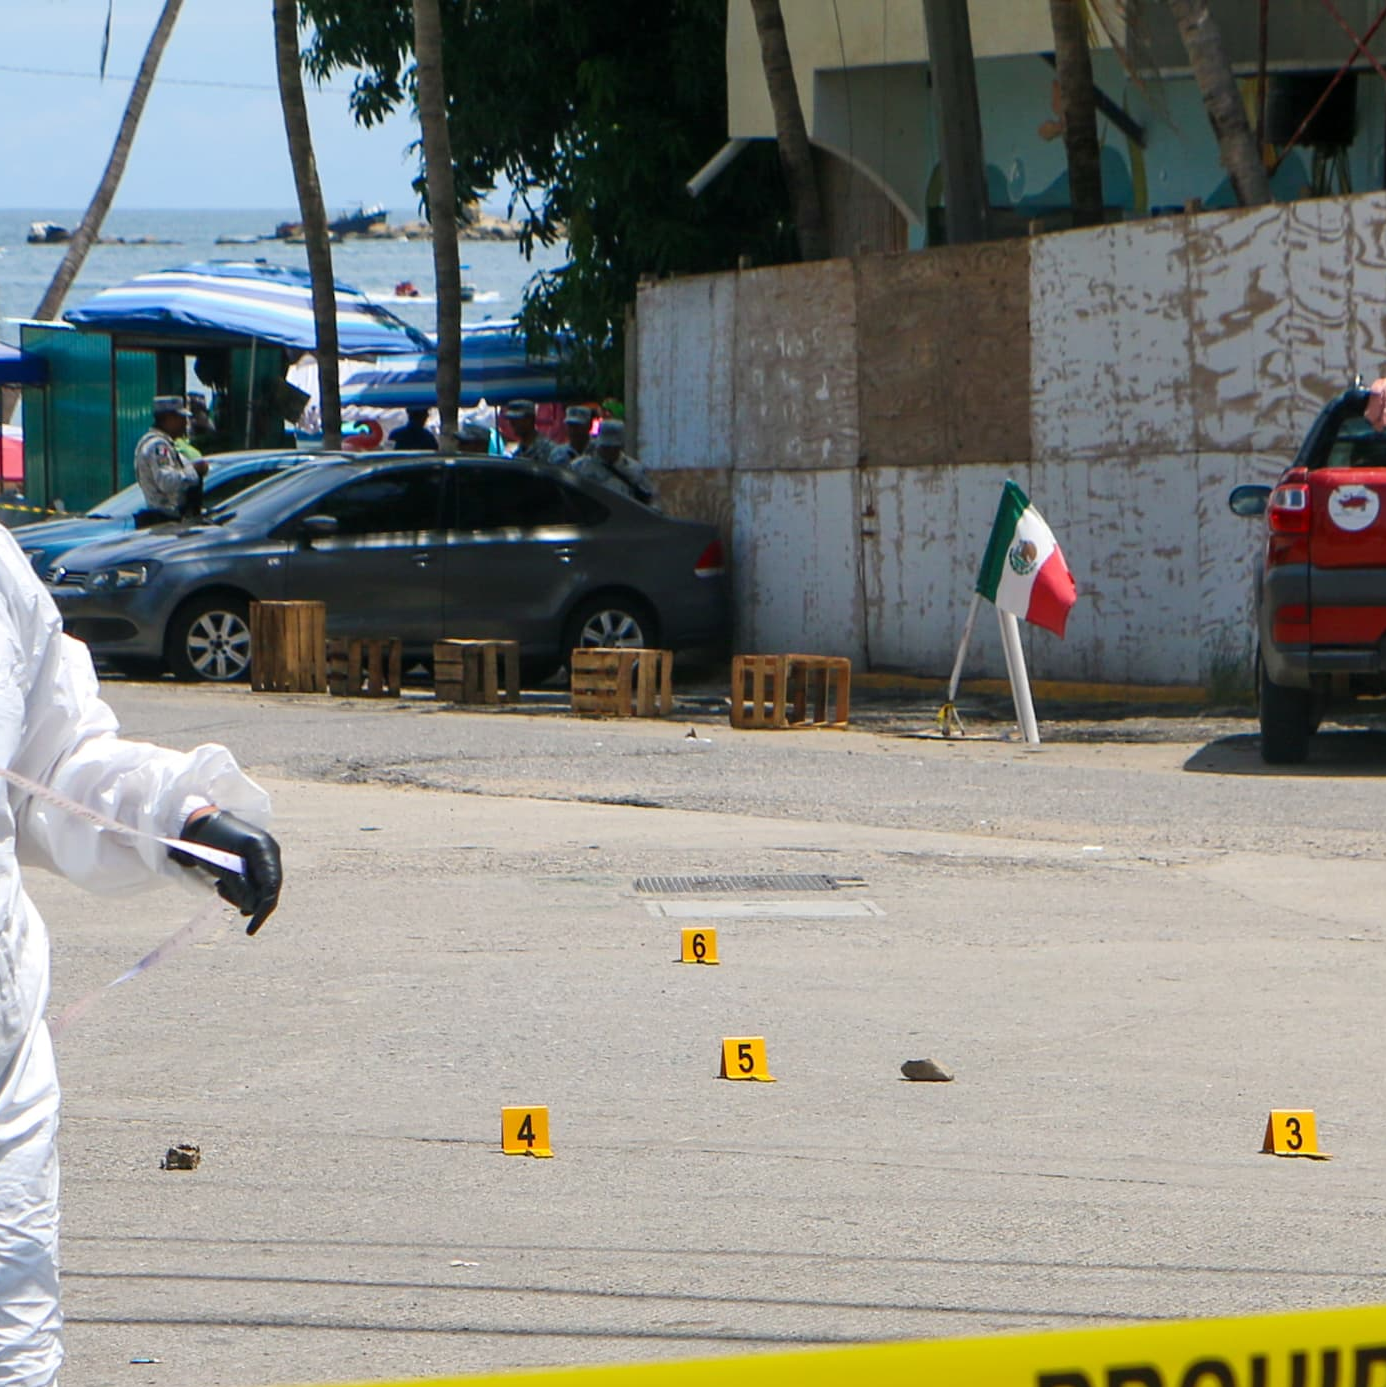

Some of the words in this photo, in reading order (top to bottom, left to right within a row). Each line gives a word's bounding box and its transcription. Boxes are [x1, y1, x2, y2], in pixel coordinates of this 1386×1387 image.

[693, 933, 706, 959] 6
[738, 1044, 754, 1073] 5
[517, 1114, 536, 1148] 4
[1285, 1117, 1302, 1150] 3
